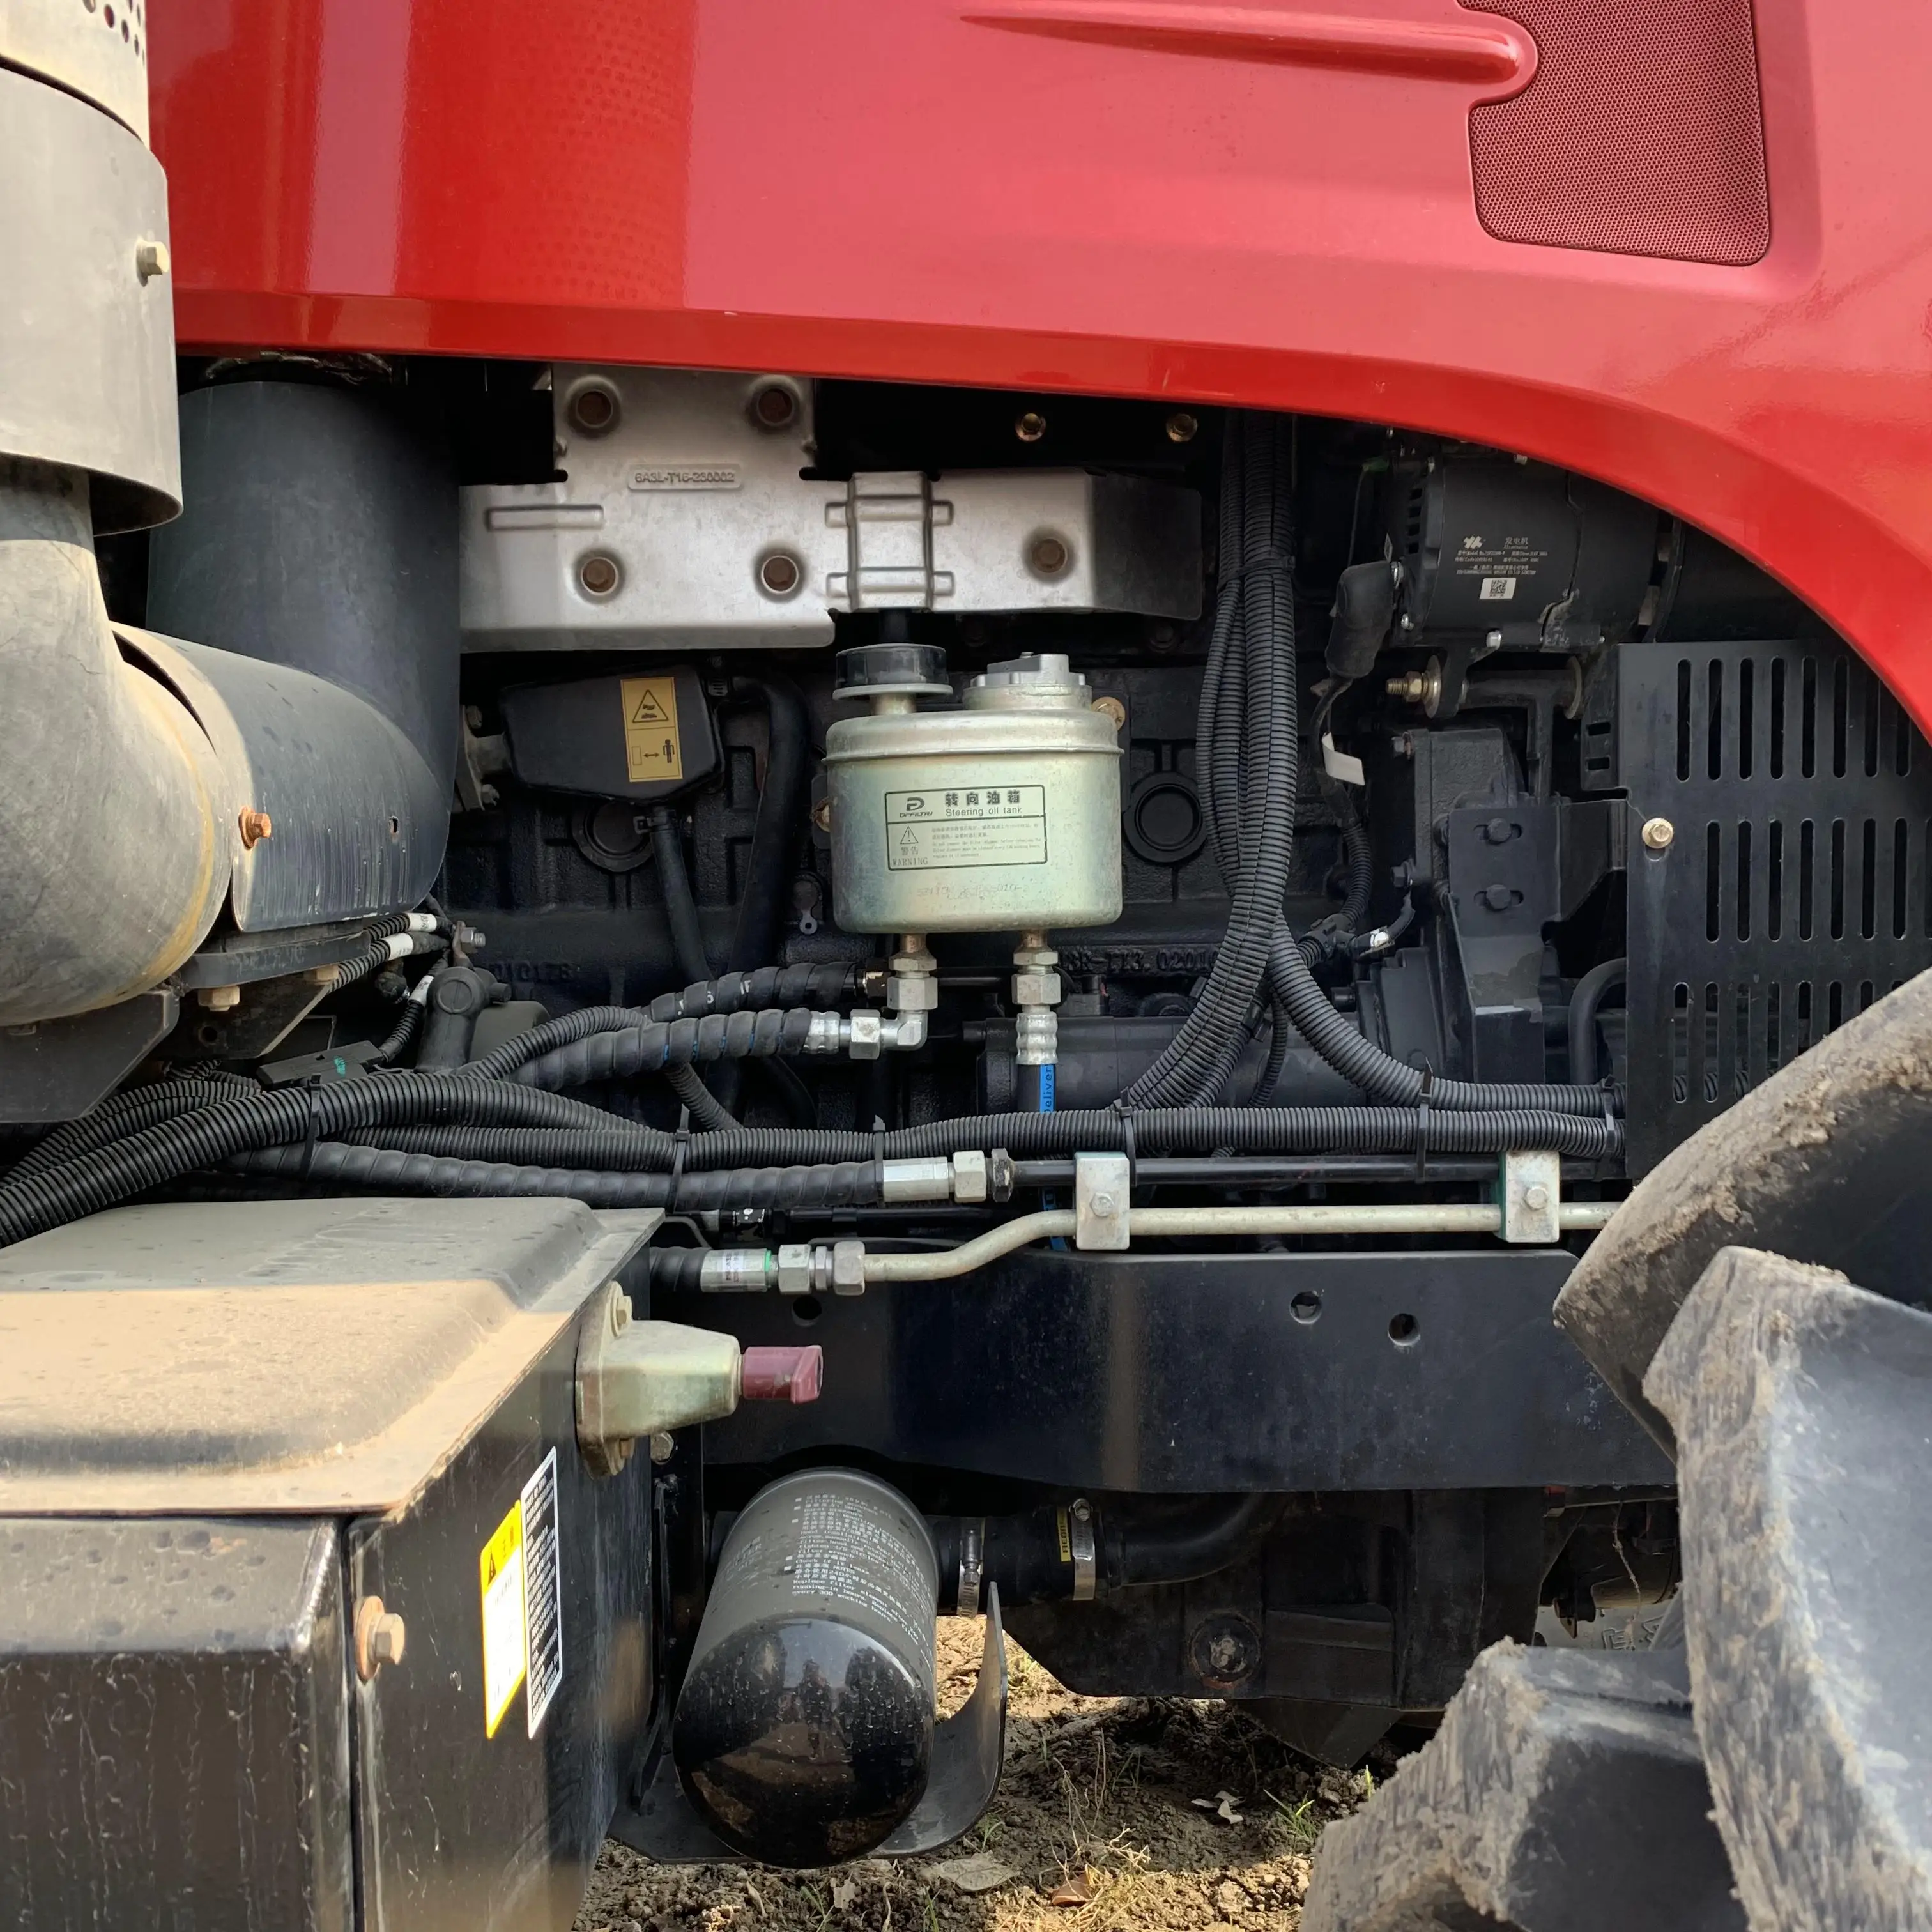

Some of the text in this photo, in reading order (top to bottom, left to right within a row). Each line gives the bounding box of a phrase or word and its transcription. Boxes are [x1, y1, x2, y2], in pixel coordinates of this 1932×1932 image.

[1505, 537, 1529, 545] 发电机
[945, 790, 1020, 806] 转向油箱
[946, 808, 984, 817] Steering
[901, 846, 919, 855] 警告
[893, 857, 928, 867] WARNING
